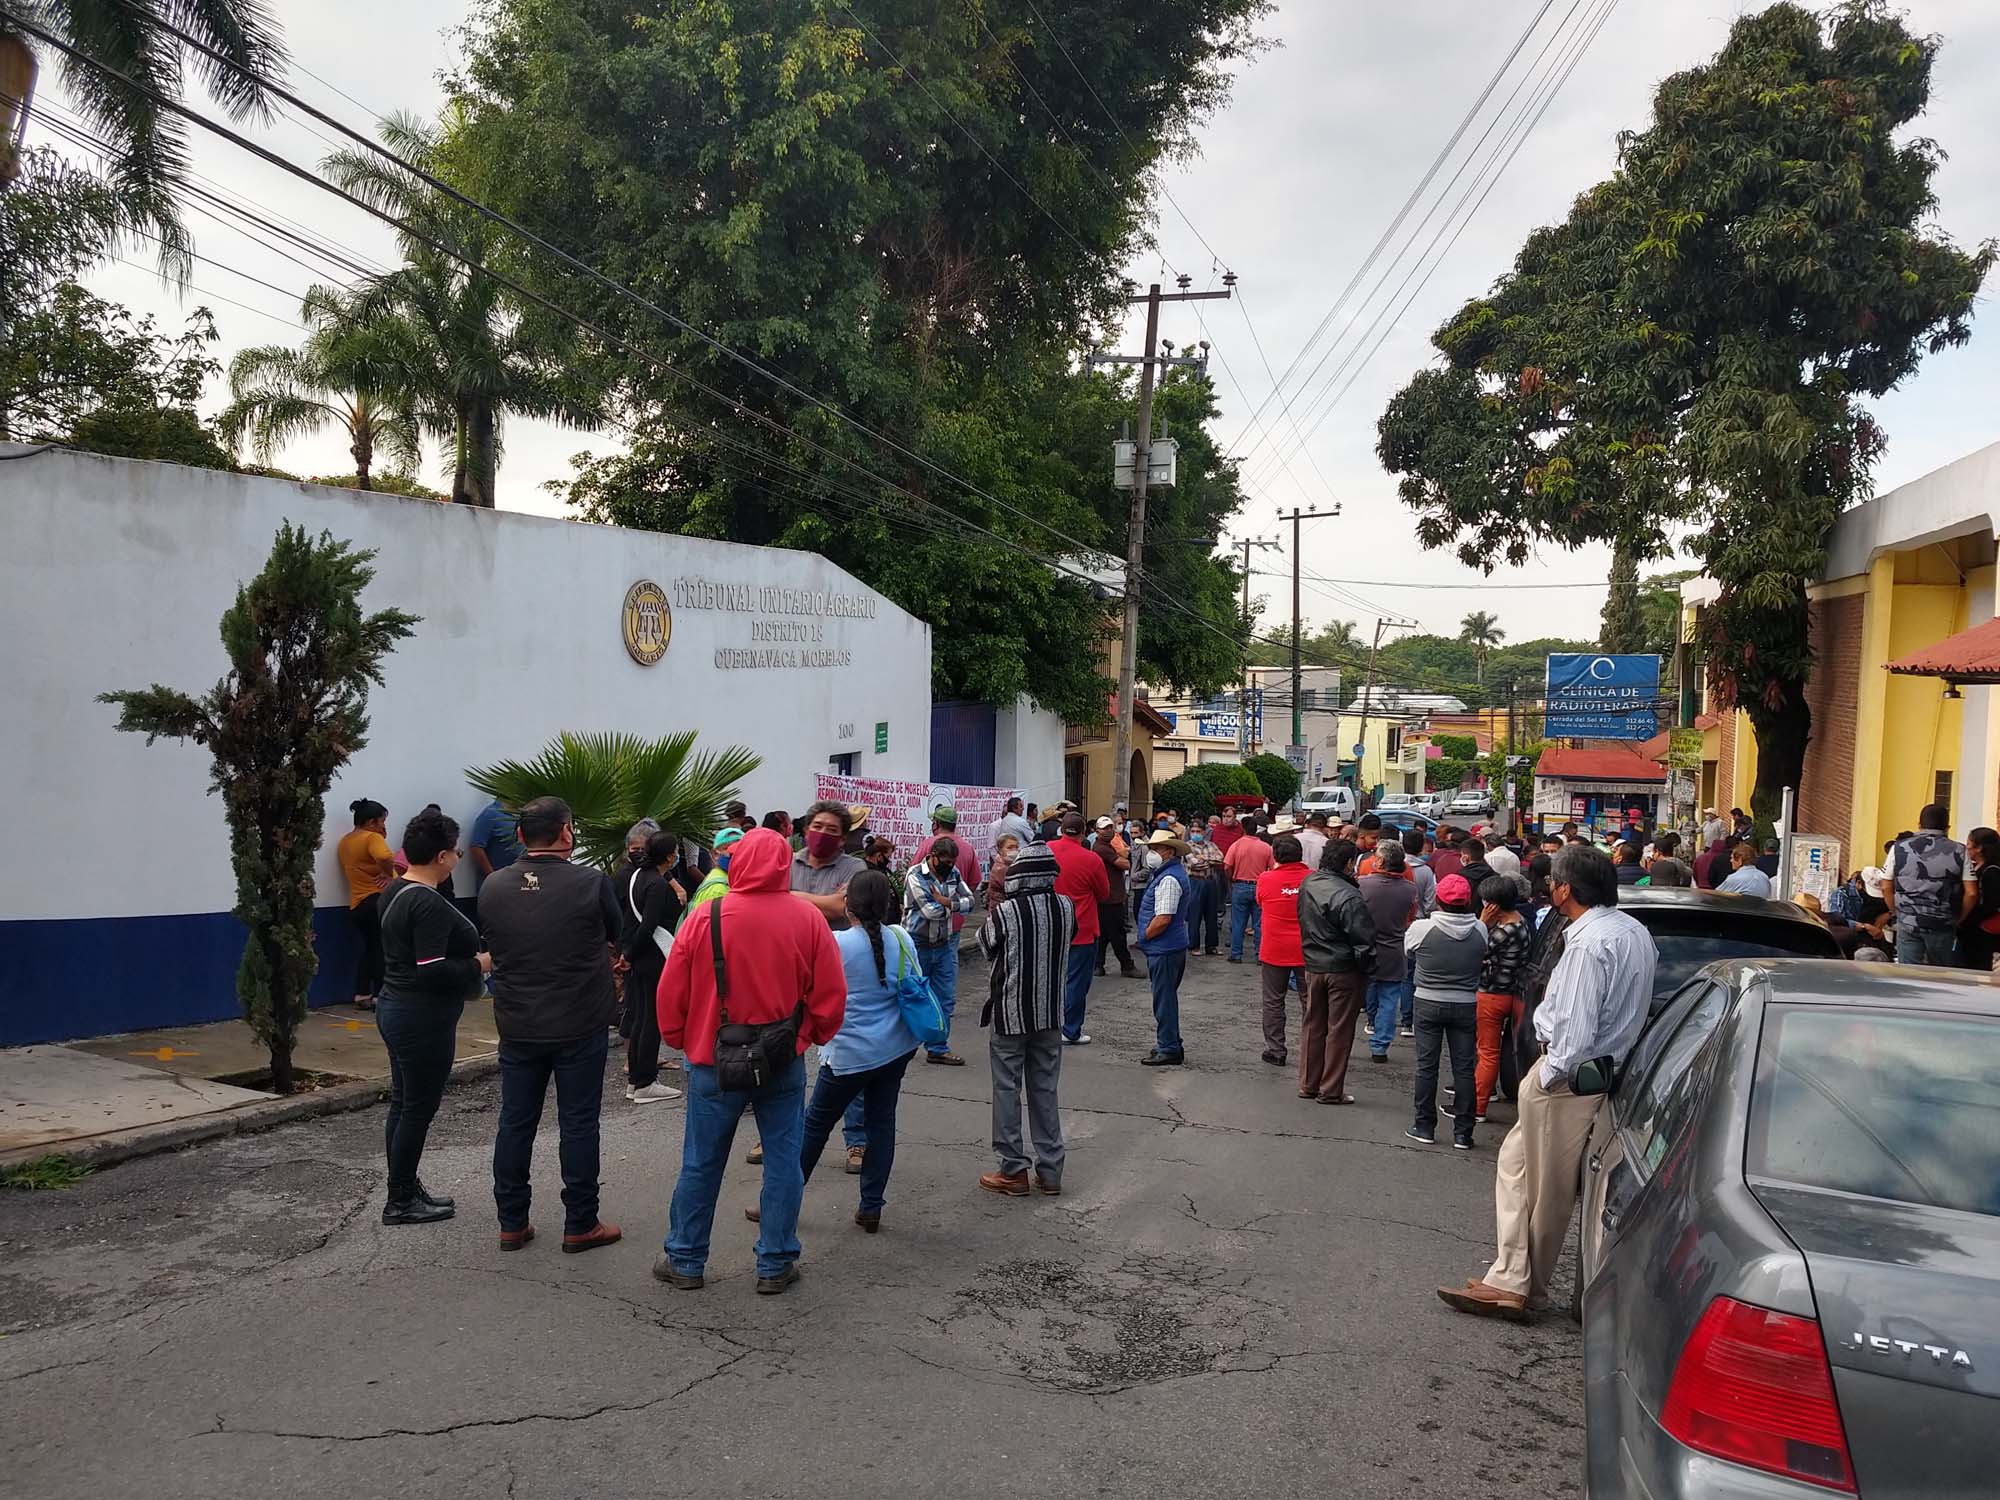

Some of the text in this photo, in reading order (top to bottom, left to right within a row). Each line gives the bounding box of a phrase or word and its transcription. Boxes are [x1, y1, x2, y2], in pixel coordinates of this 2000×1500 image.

[673, 577, 876, 620] TRIBUNAL UNITARIO AGRARIO
[752, 621, 807, 642] DISTRITO
[714, 649, 851, 670] CUERNAVACA MORELOS
[1561, 684, 1639, 697] CLÍNICA DE
[852, 778, 894, 794] COMUNIDADES
[895, 782, 904, 793] DE
[904, 783, 930, 798] MORELOS
[899, 795, 921, 808] CLAUDIA
[880, 820, 891, 834] LOS
[892, 821, 914, 834] IDEALES
[1840, 1331, 1973, 1367] JETTA
